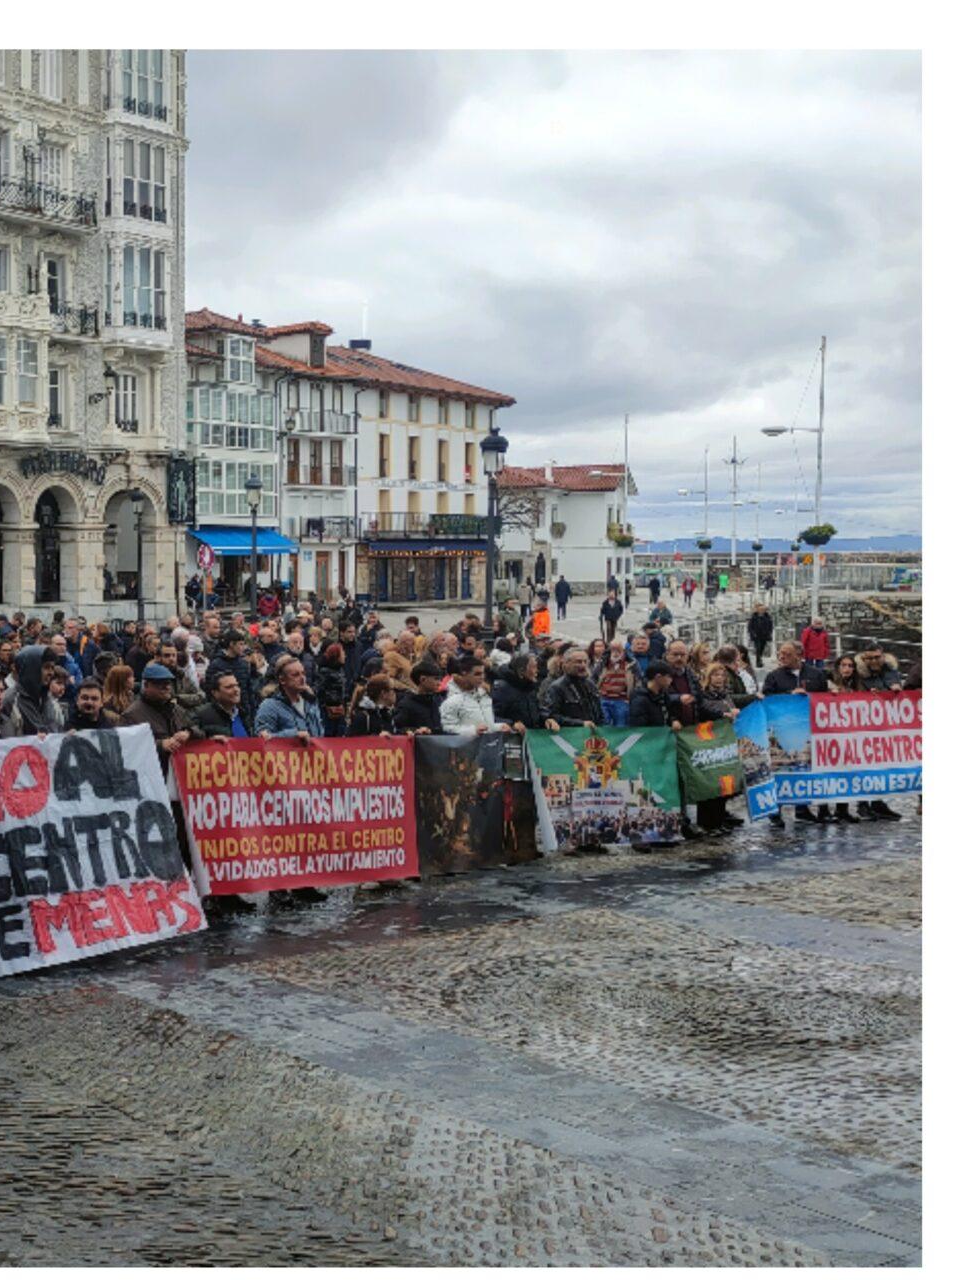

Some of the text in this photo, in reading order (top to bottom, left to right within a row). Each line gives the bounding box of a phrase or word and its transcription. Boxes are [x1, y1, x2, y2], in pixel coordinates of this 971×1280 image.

[815, 699, 884, 729] CASTRO
[885, 698, 915, 726] NO
[53, 728, 143, 801] AL
[816, 738, 841, 767] NO
[843, 738, 862, 766] AL
[185, 747, 405, 790] RECURSOS PARA CASTRO
[775, 777, 848, 798] ACISMO
[852, 774, 887, 794] SON
[187, 785, 405, 830] NO PARA CENTROS IMPUESTOS
[262, 832, 329, 855] CONTRA
[332, 831, 347, 851] EL
[352, 826, 405, 849] CENTRO
[278, 855, 304, 876] DEL
[305, 847, 405, 874] AYUNTAMIENTO
[30, 879, 201, 954] MENAS
